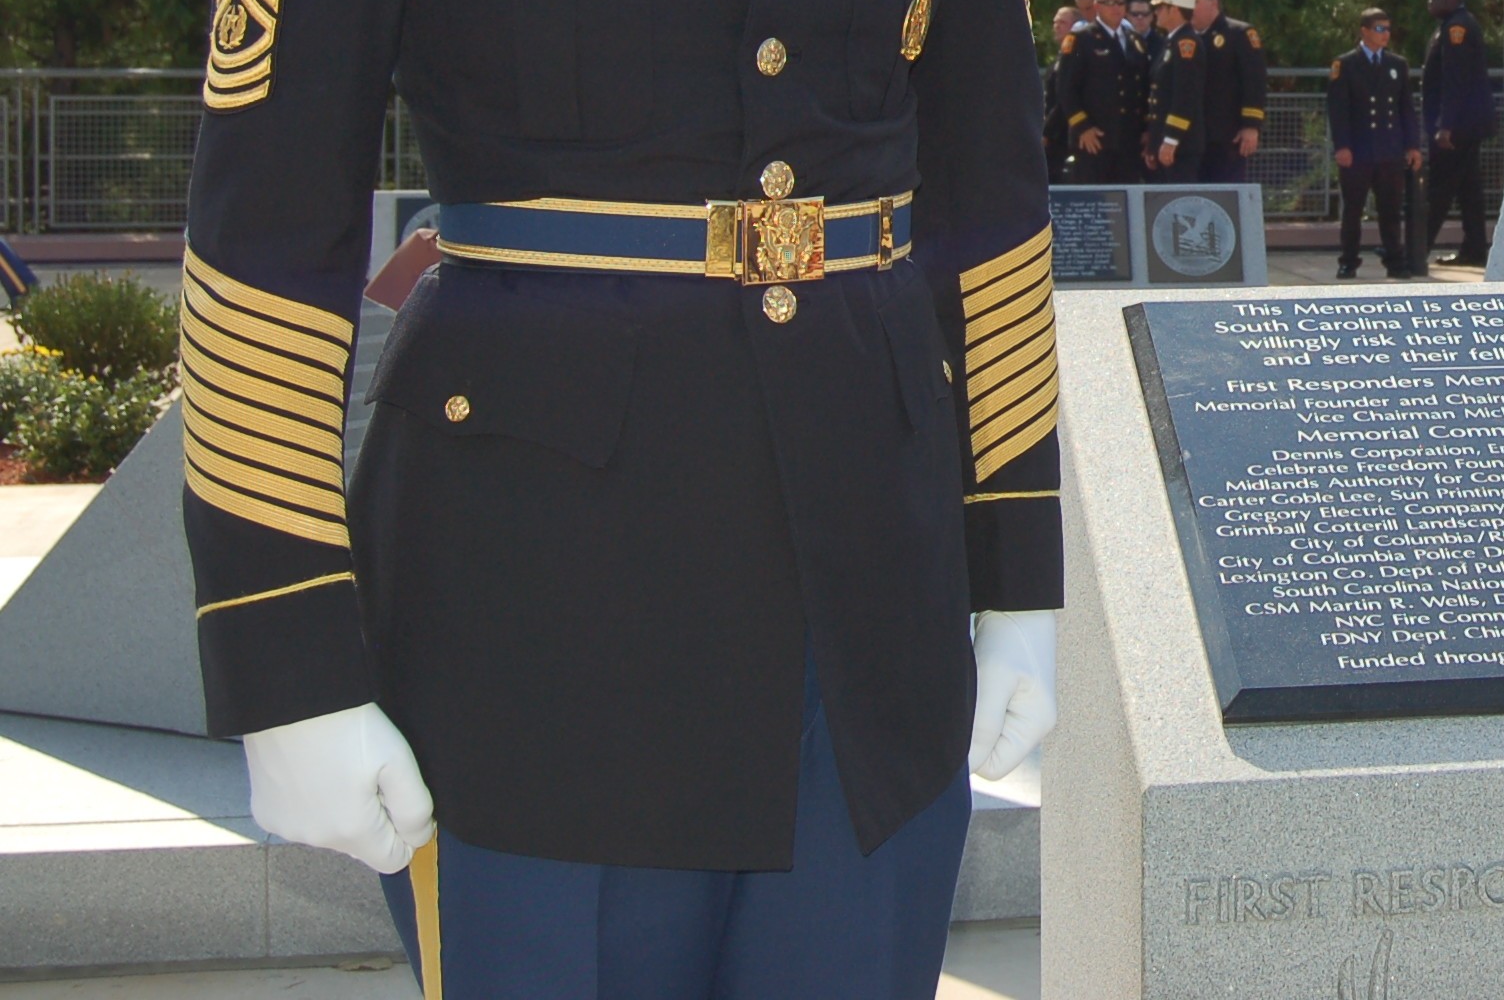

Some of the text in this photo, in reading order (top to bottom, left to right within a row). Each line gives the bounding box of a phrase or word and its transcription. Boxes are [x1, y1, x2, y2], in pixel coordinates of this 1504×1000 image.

[1233, 304, 1282, 316] This
[1294, 300, 1412, 314] Memorial
[1423, 303, 1441, 312] is
[1214, 319, 1289, 333] South
[1297, 317, 1402, 331] Carolina
[1411, 316, 1462, 328] First
[1239, 335, 1340, 351] willingly
[1352, 333, 1396, 346] risk
[1405, 332, 1462, 345] their
[1263, 352, 1310, 366] and
[1322, 353, 1390, 364] serve
[1400, 349, 1458, 362] their
[1226, 380, 1277, 392] First
[1287, 375, 1434, 393] Responders
[1195, 398, 1296, 412] Memorial
[1304, 396, 1389, 409] Founder
[1399, 394, 1438, 406] and
[1296, 412, 1344, 423] Vice
[1352, 409, 1455, 421] Chairman
[1297, 425, 1419, 442] Memorial
[1290, 537, 1333, 551] City
[1343, 535, 1363, 547] of
[1272, 584, 1336, 597] South
[1343, 581, 1433, 594] Carolina
[1244, 602, 1299, 615] CSM
[1309, 598, 1381, 612] Martin
[1335, 614, 1384, 628] NYC
[1392, 613, 1430, 625] Fire
[1320, 630, 1381, 645] FDNY
[1337, 651, 1425, 668] Funded
[1184, 870, 1331, 926] FIRST
